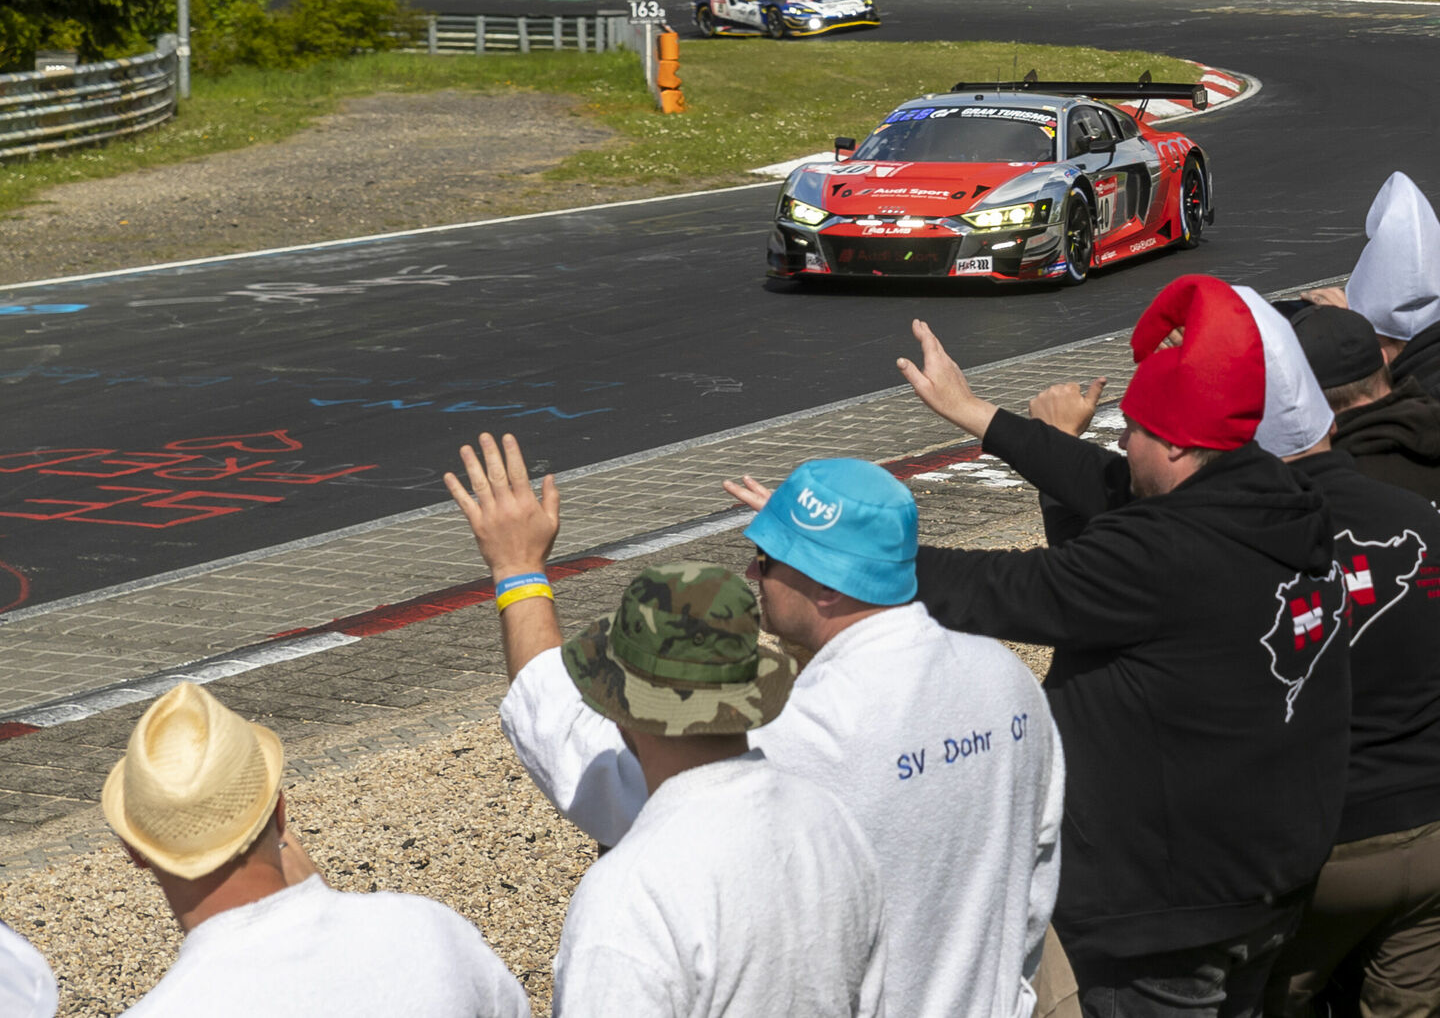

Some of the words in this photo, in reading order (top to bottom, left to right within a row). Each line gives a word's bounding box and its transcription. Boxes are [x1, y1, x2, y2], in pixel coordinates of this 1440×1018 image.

[961, 107, 997, 116] GRAN
[997, 108, 1051, 122] TURISMO
[909, 188, 950, 197] Sport
[897, 748, 926, 780] SV
[944, 729, 993, 763] Dohr
